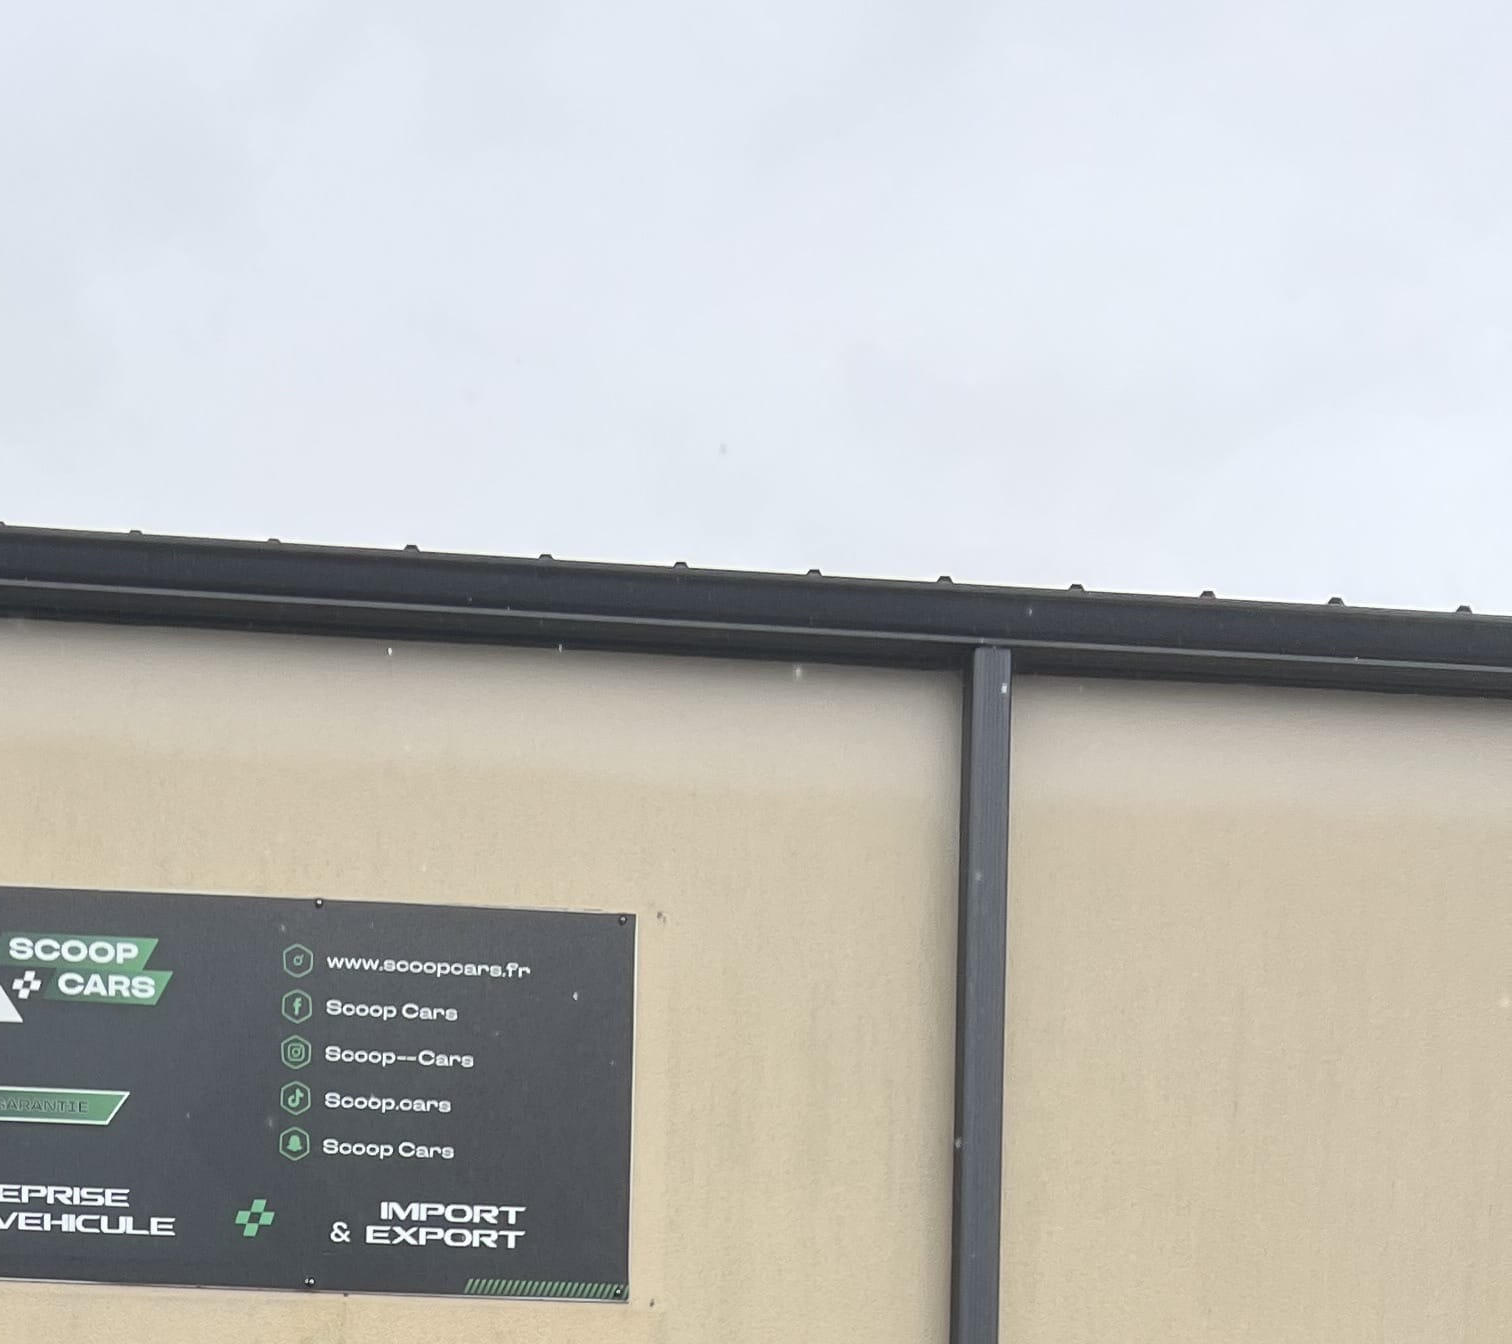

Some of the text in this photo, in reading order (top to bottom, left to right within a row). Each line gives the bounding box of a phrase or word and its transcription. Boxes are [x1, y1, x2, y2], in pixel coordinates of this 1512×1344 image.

[8, 937, 139, 964] SCOOP
[326, 955, 531, 979] www.scoopcars.fr
[57, 972, 156, 998] CARS
[326, 999, 458, 1021] Scoop Cars
[324, 1092, 452, 1113] Scoop.cars
[322, 1139, 455, 1160] Scoop Cars
[380, 1201, 527, 1225] IMPORT
[330, 1221, 526, 1249] & EXPORT
